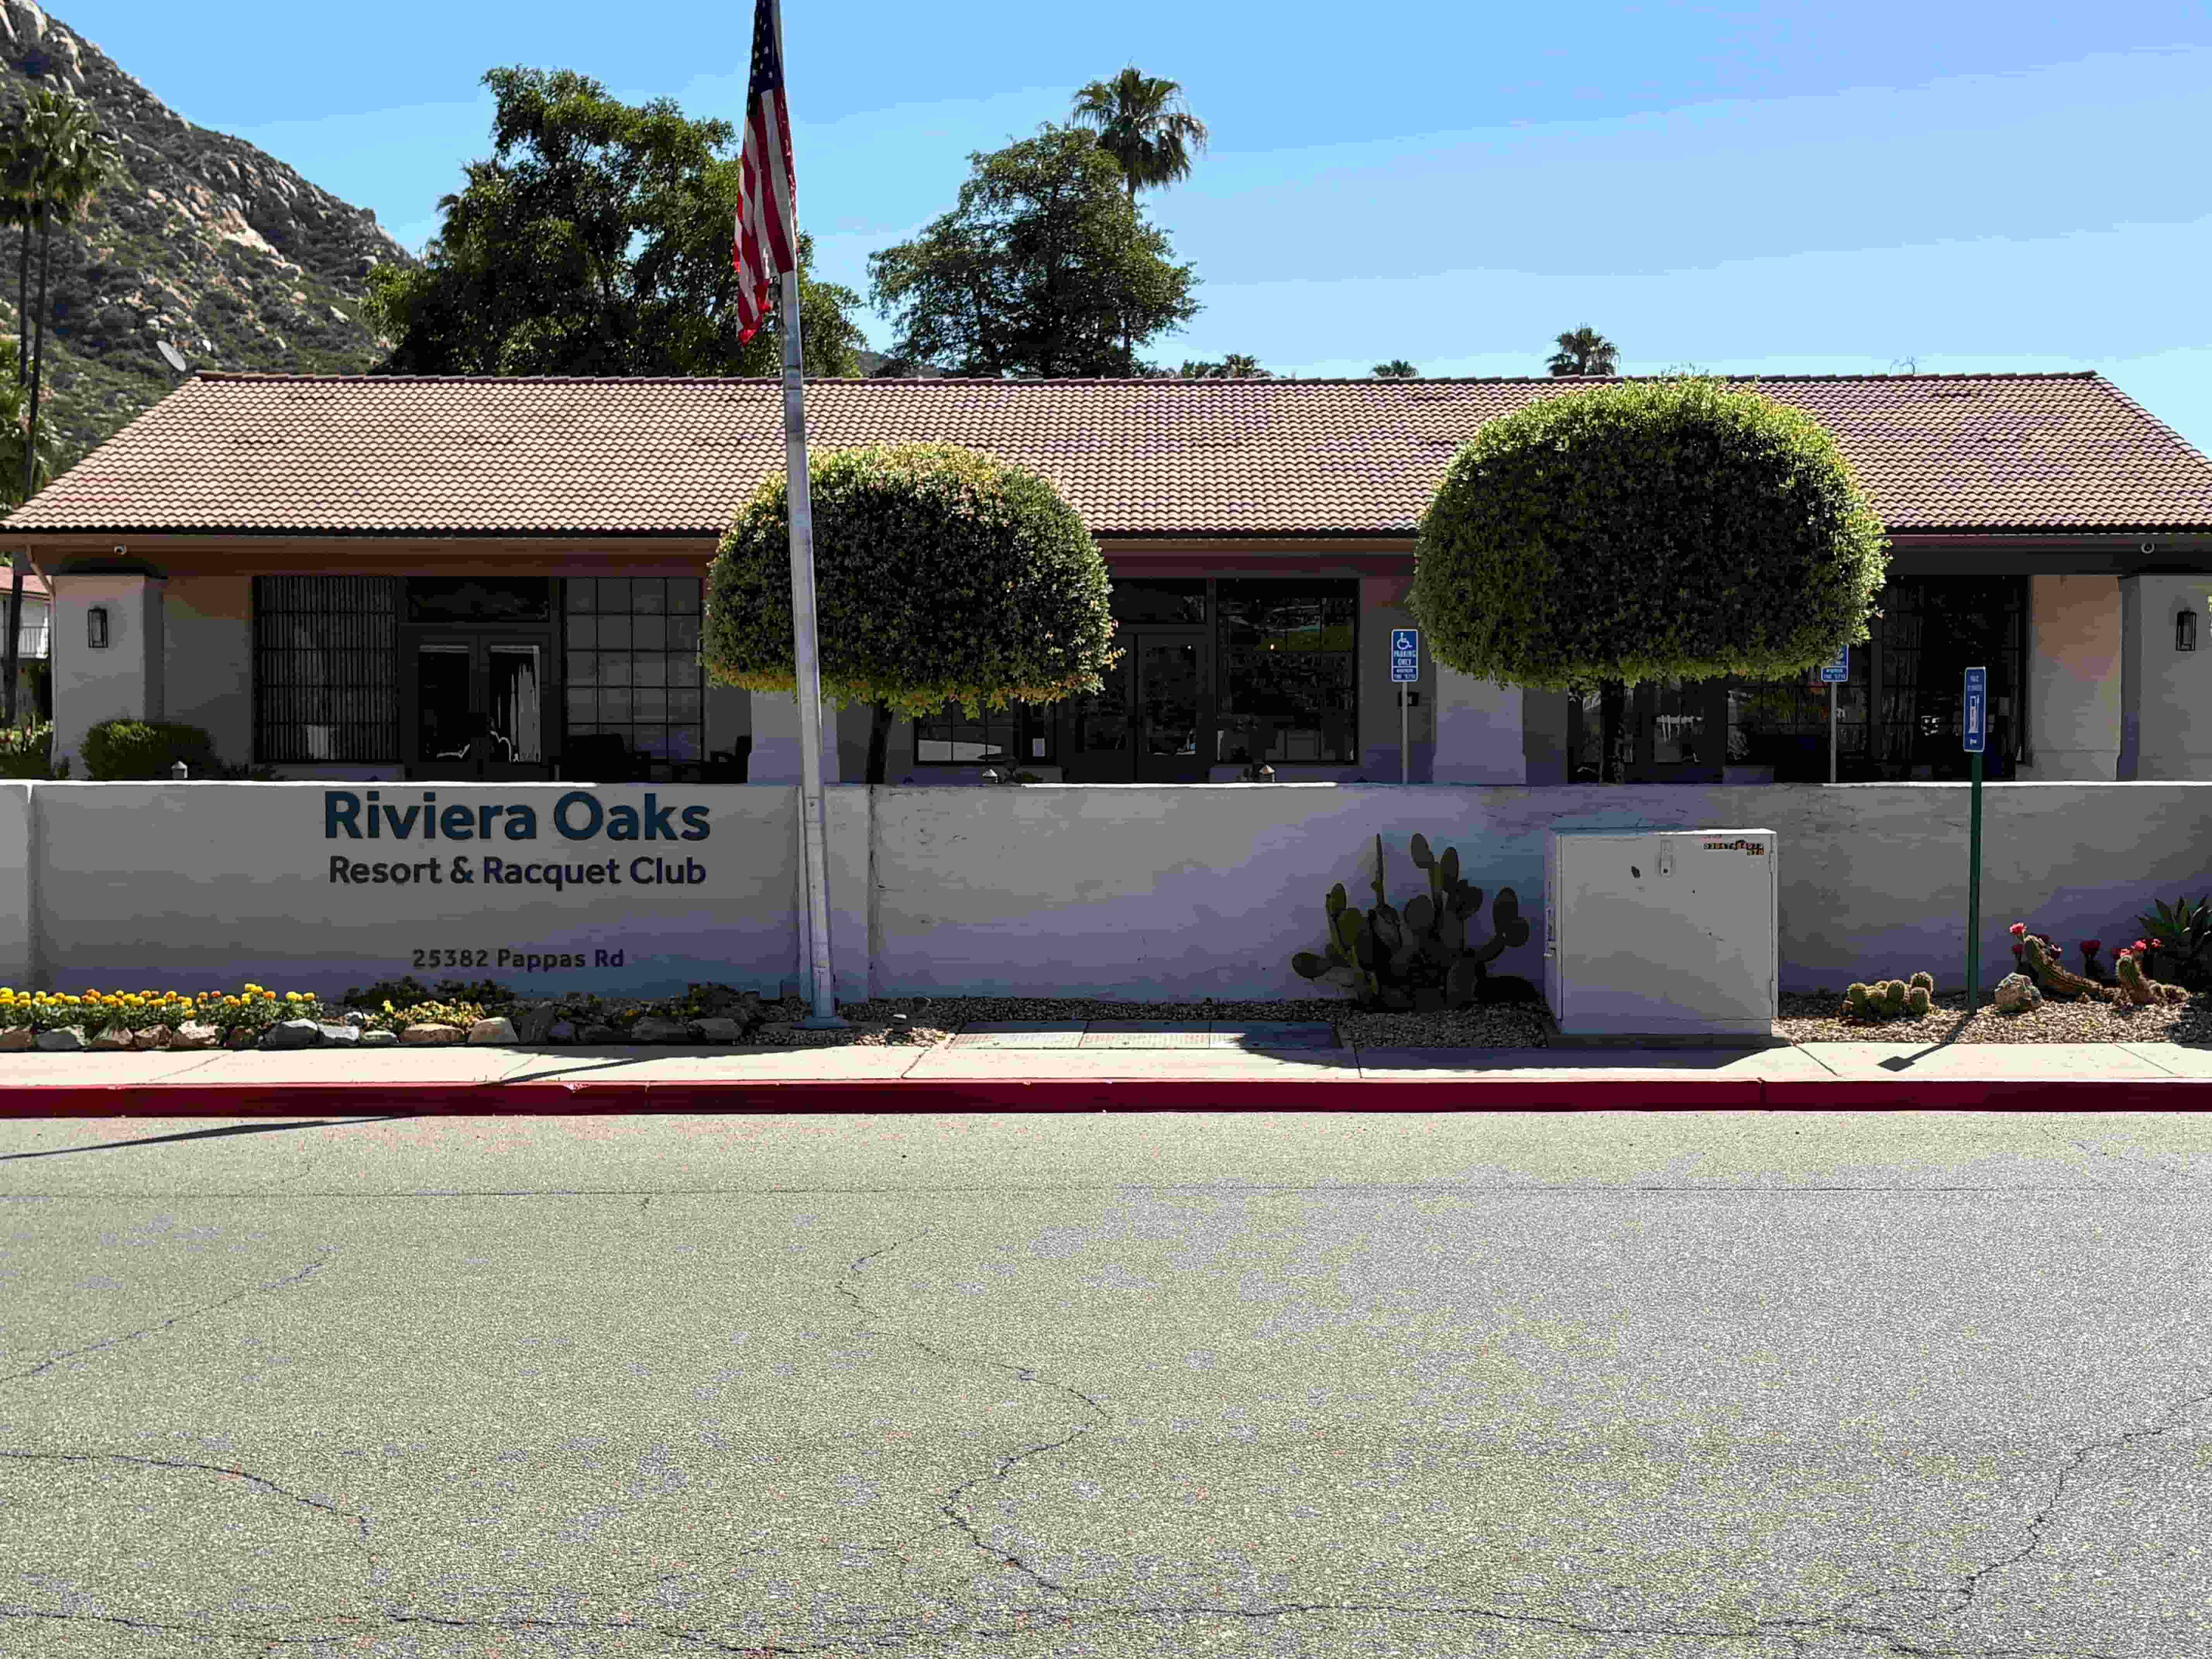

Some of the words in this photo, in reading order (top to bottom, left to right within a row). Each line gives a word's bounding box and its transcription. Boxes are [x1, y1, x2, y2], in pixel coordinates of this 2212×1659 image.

[325, 790, 537, 840] Riviera
[553, 791, 711, 841] Oaks
[329, 855, 443, 884] Resort
[450, 856, 474, 884] &
[484, 856, 622, 892] Racquet
[630, 856, 707, 885] Club
[412, 949, 490, 968] 25382
[498, 948, 586, 973] Pappas
[595, 949, 624, 968] Rd
